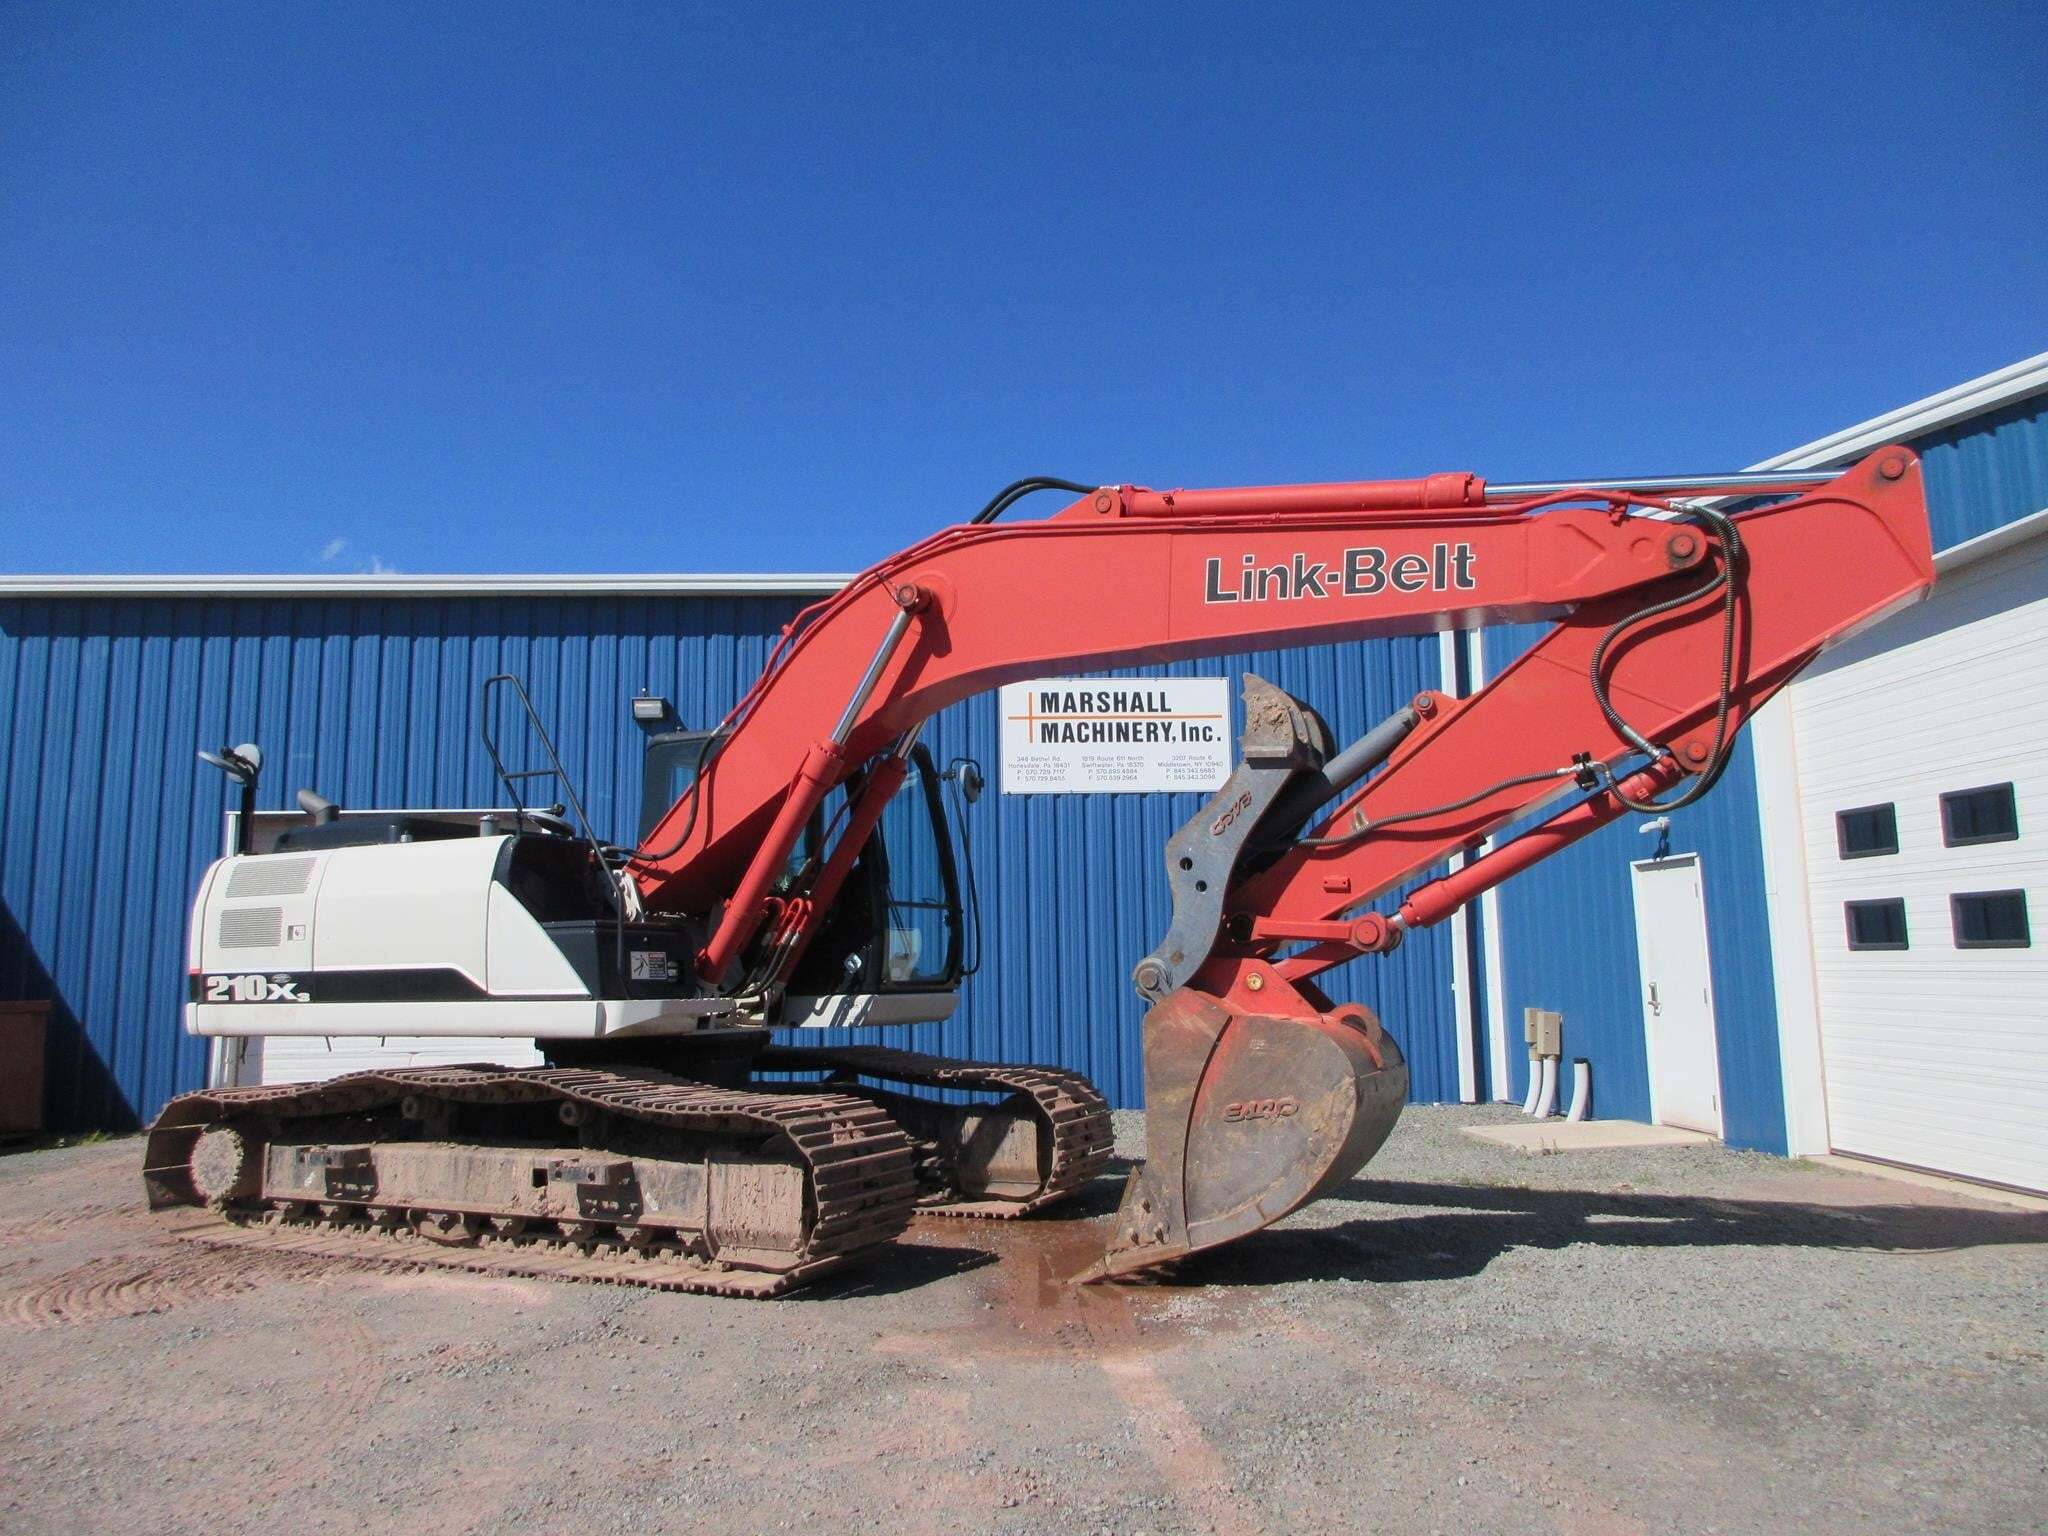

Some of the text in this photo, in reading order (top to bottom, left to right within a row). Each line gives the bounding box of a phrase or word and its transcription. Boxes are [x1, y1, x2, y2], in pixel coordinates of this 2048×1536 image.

[1205, 543, 1476, 605] Link-Belt
[1040, 691, 1172, 713] MARSHALL
[1041, 721, 1222, 744] MACHINERY, Inc.
